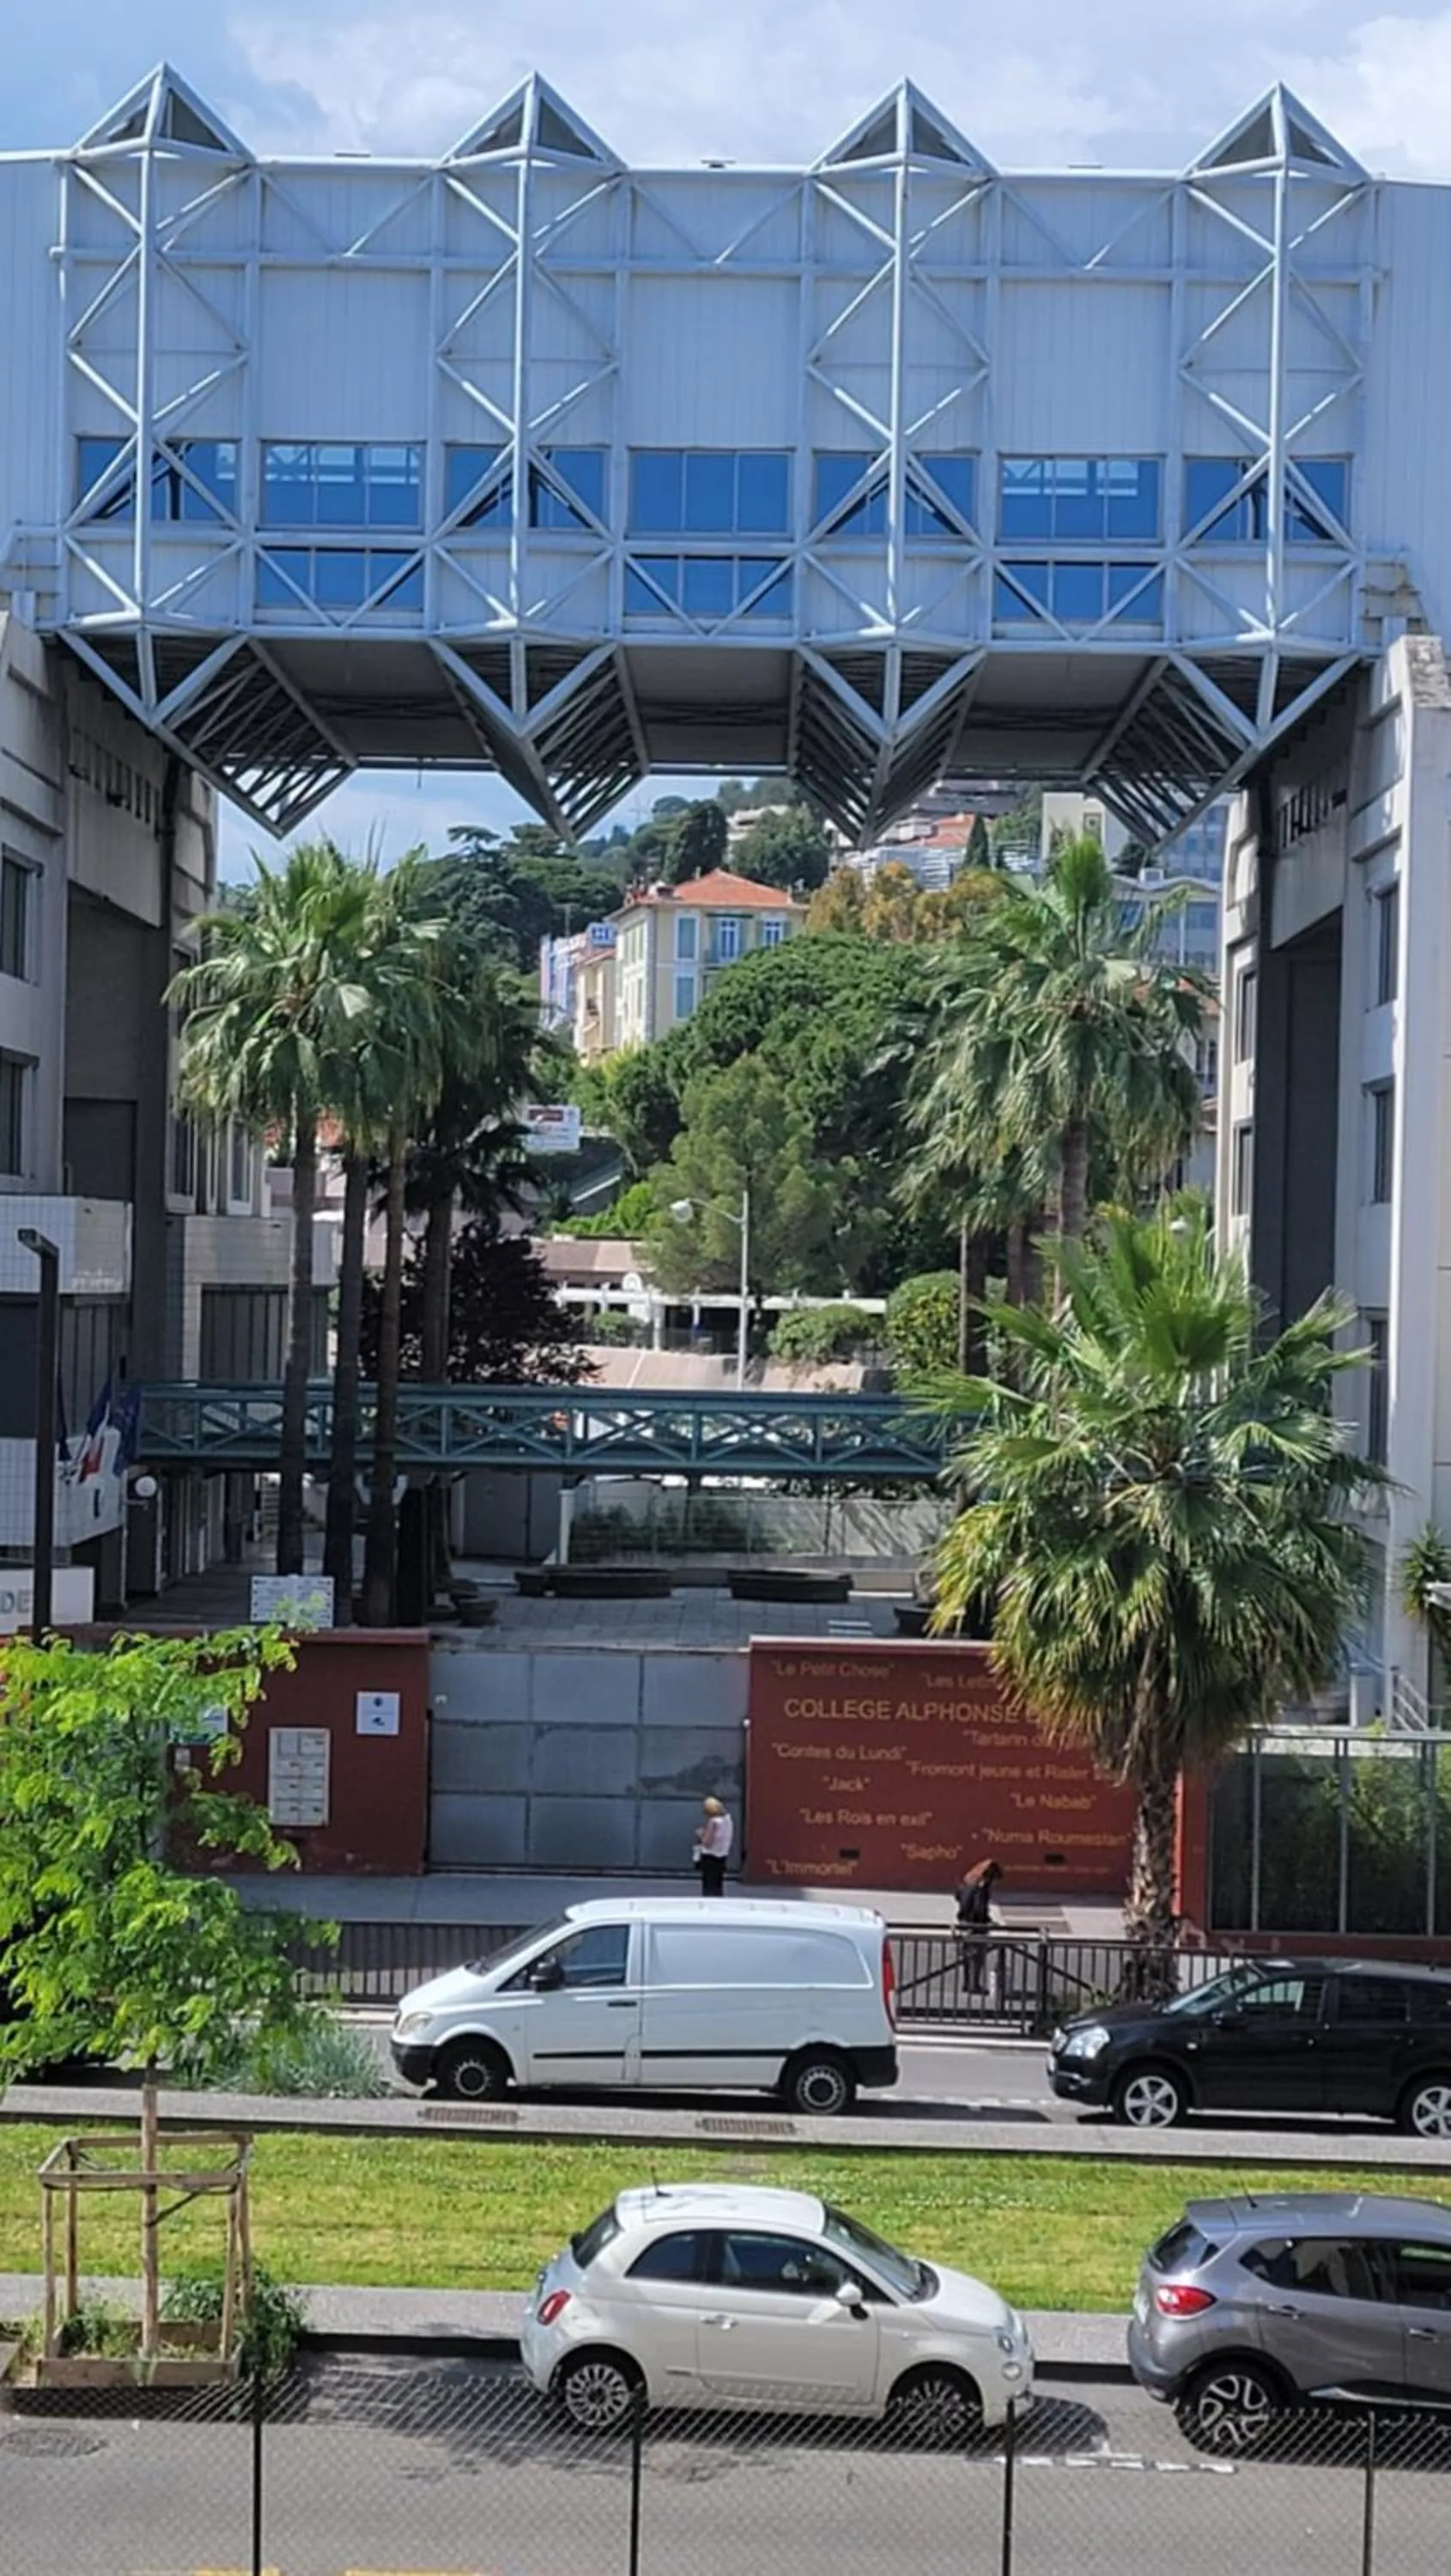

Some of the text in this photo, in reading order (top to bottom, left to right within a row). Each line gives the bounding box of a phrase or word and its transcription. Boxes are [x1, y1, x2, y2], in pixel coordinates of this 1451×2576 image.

[784, 1698, 891, 1720] COLLEGE
[895, 1701, 1018, 1723] ALPHONSE
[835, 1745, 855, 1759] du
[979, 1763, 1021, 1781] jeune
[1025, 1765, 1041, 1778] et
[837, 1808, 872, 1826] Rois
[876, 1814, 896, 1826] en
